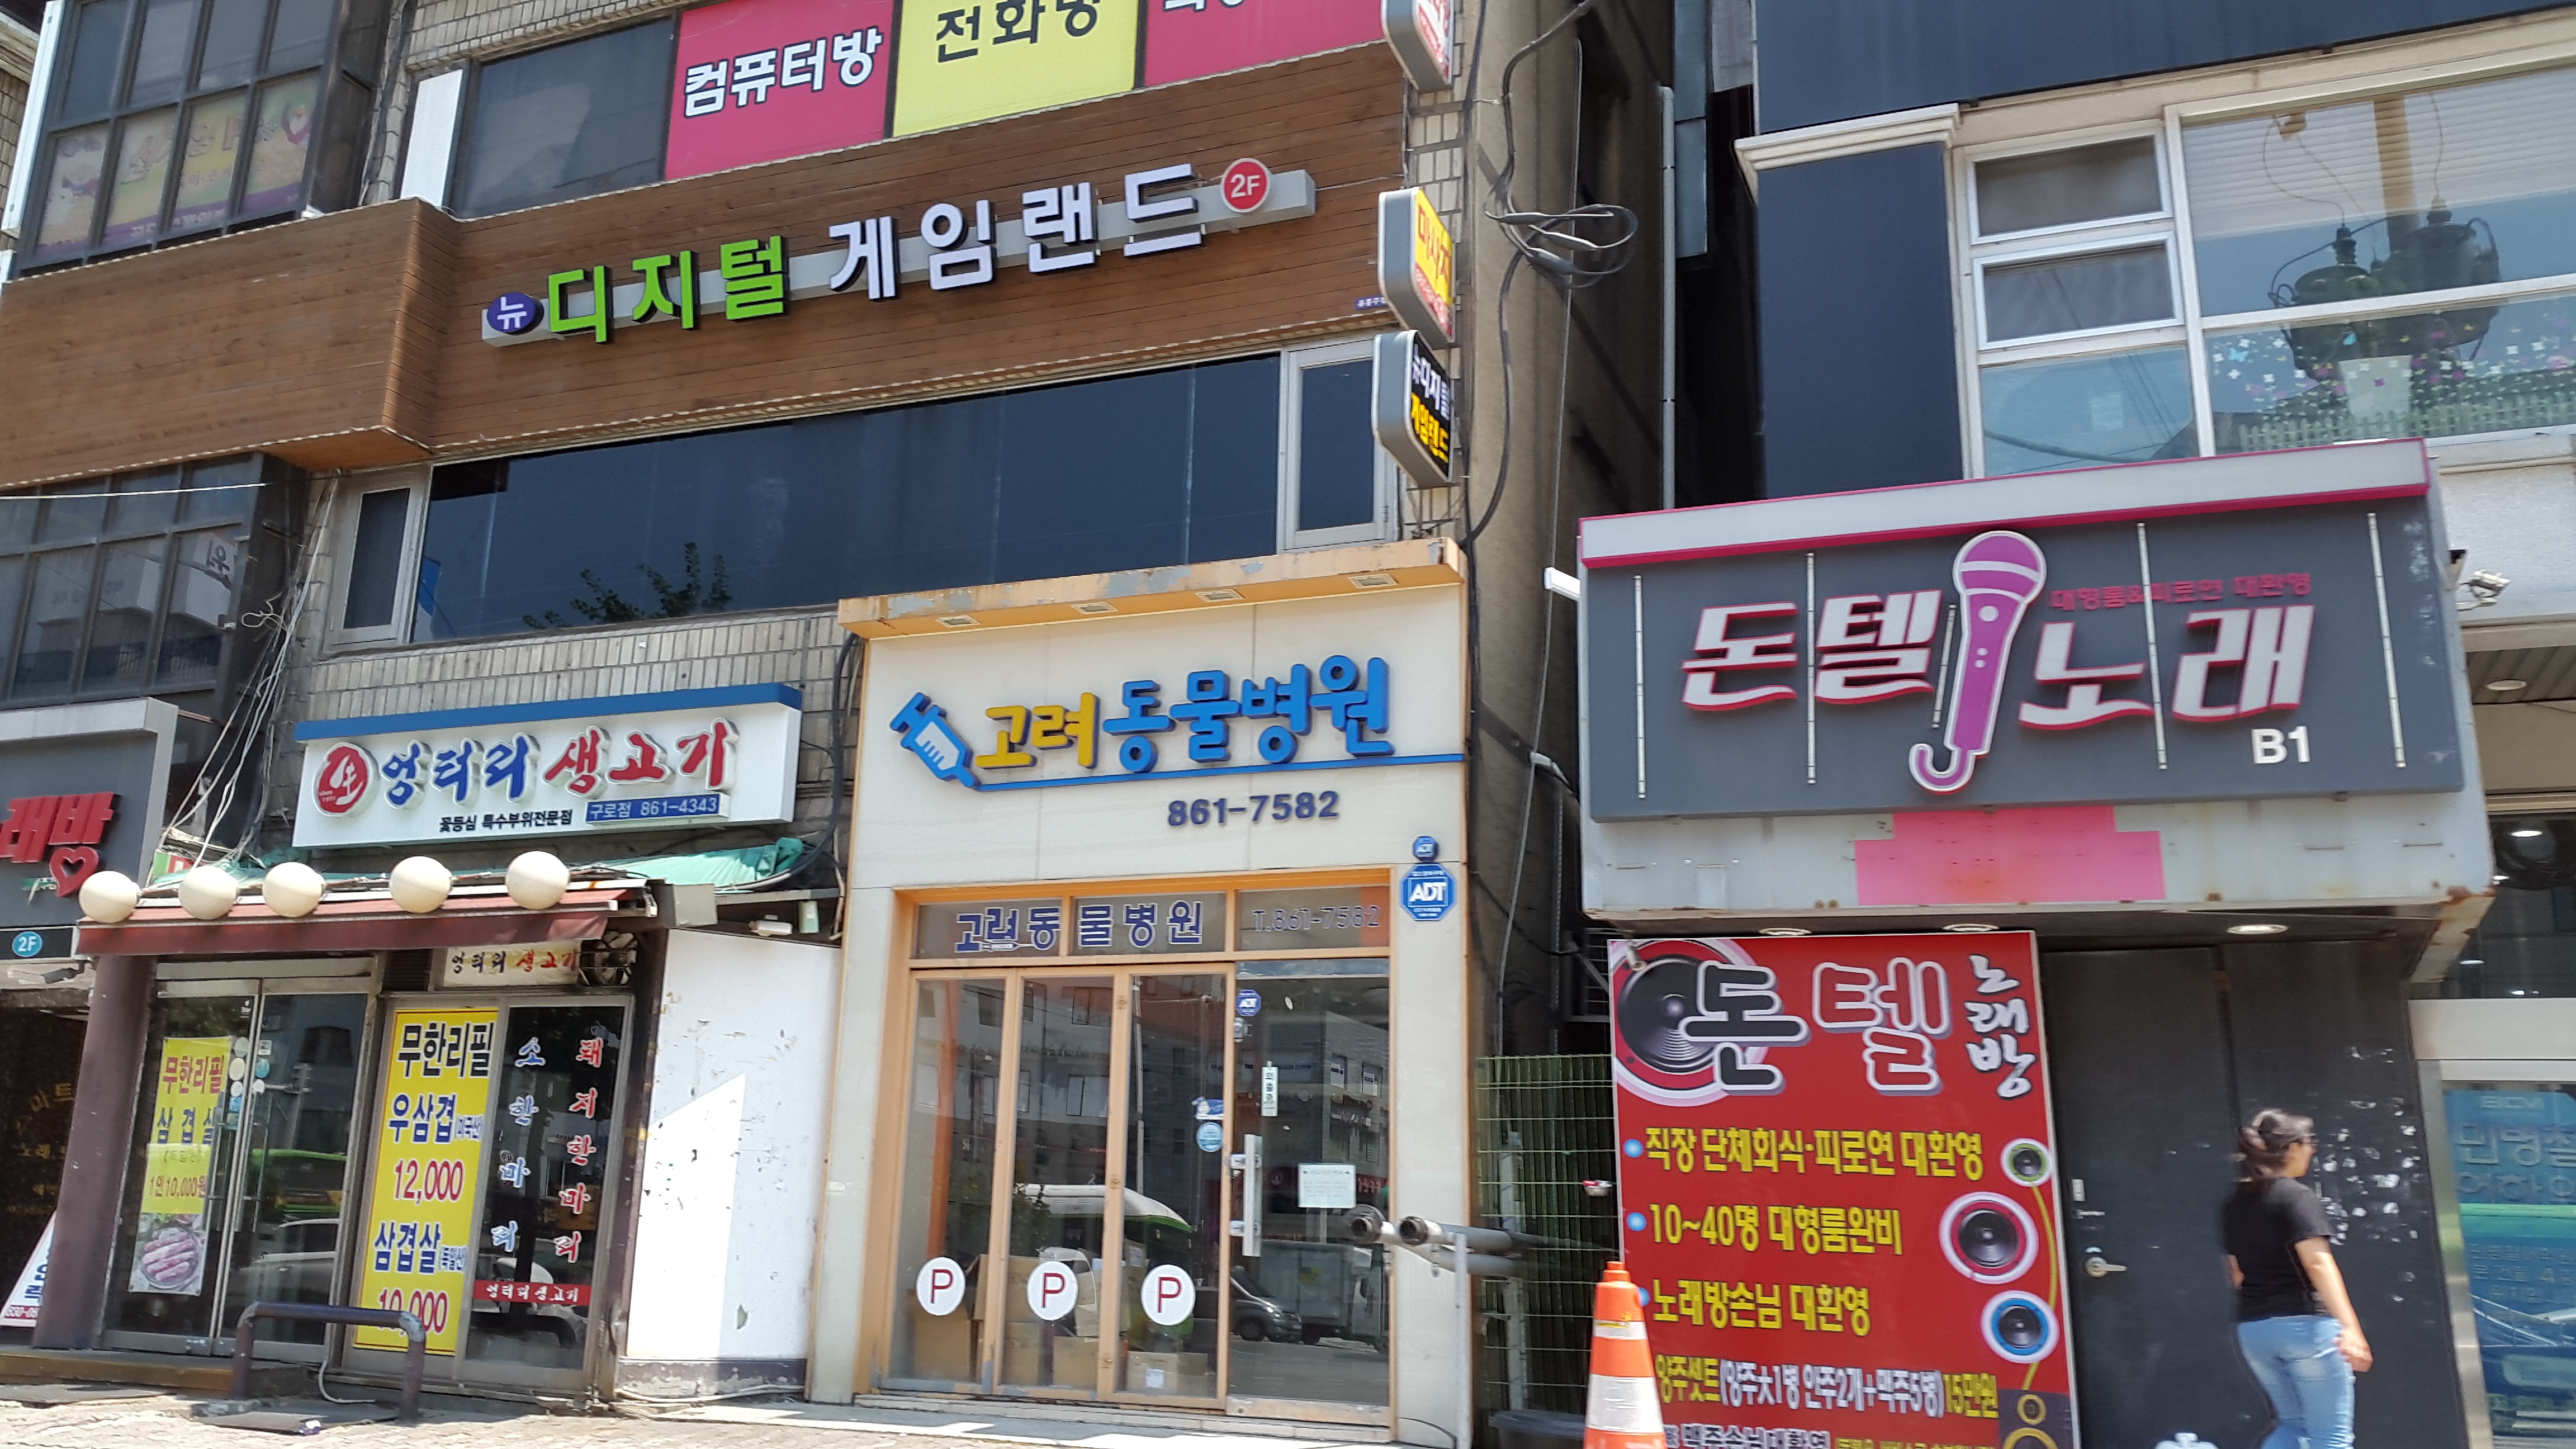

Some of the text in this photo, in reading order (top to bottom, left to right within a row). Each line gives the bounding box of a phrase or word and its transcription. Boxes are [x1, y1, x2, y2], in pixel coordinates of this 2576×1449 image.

[684, 27, 883, 117] 컴퓨터방
[499, 163, 1261, 343] 뉴 디지털 게임랜드 2F
[2233, 572, 2312, 598] 대환영
[1682, 588, 2315, 730] 돈텔 노래
[976, 655, 1394, 773] 고려동물병원
[382, 718, 729, 806] 엉터리 생고기
[2251, 726, 2310, 764] B1
[439, 809, 573, 832] 꽃등심 특수부위전문점
[590, 797, 718, 818] 구로점 861-4343
[1167, 790, 1339, 826] 861-7582
[1409, 882, 1448, 902] ADT
[954, 899, 1204, 953] 고려동물병원
[1251, 904, 1381, 933] T.861-7582
[17, 936, 37, 952] 2F
[451, 949, 577, 974] 엉터리 생고기
[397, 1021, 495, 1078] 무한리필
[1677, 956, 1952, 1096] 돈텔
[1965, 954, 2037, 1098] 노래방
[163, 1054, 224, 1095] 무한리필
[387, 1092, 457, 1144] 우삼겹
[1645, 1127, 1983, 1181] 직장 단체회식·피로연 대환영
[394, 1158, 465, 1206] 12,000
[373, 1220, 442, 1275] 삼겹살
[1649, 1203, 1903, 1256] 10~40명 대형룸완비
[930, 1268, 954, 1305] P
[1041, 1272, 1066, 1309] P
[1158, 1276, 1182, 1314] P
[1652, 1278, 1871, 1337] 노래방손님 대환영
